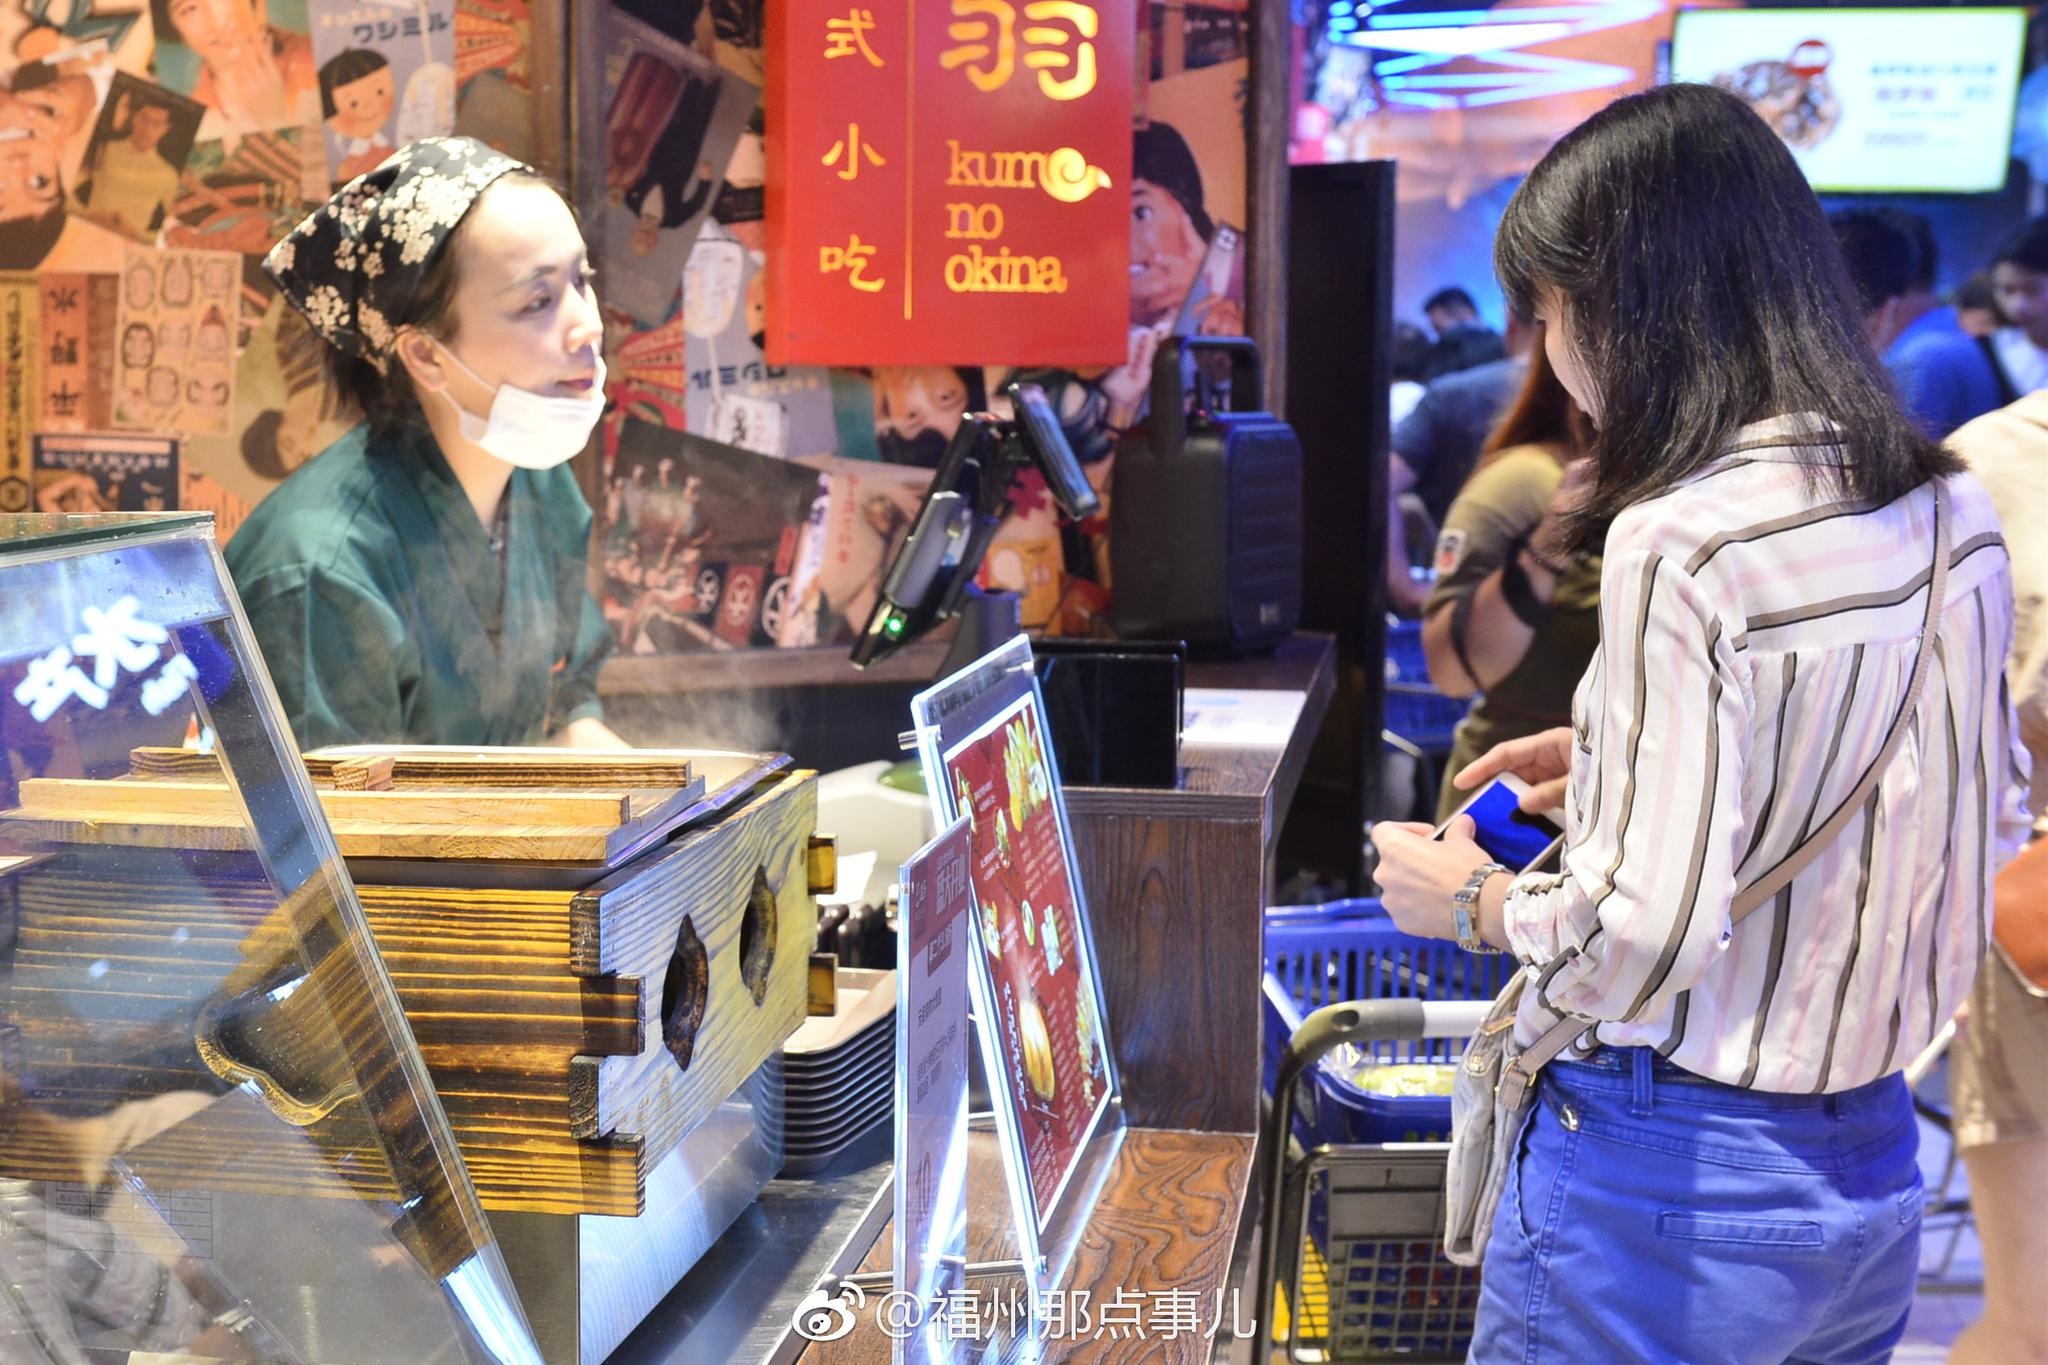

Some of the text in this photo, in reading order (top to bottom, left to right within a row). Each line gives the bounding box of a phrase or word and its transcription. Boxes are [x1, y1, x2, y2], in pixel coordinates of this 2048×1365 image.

[820, 8, 886, 293] 式小吃
[945, 202, 1004, 239] no
[944, 244, 1068, 293] okina
